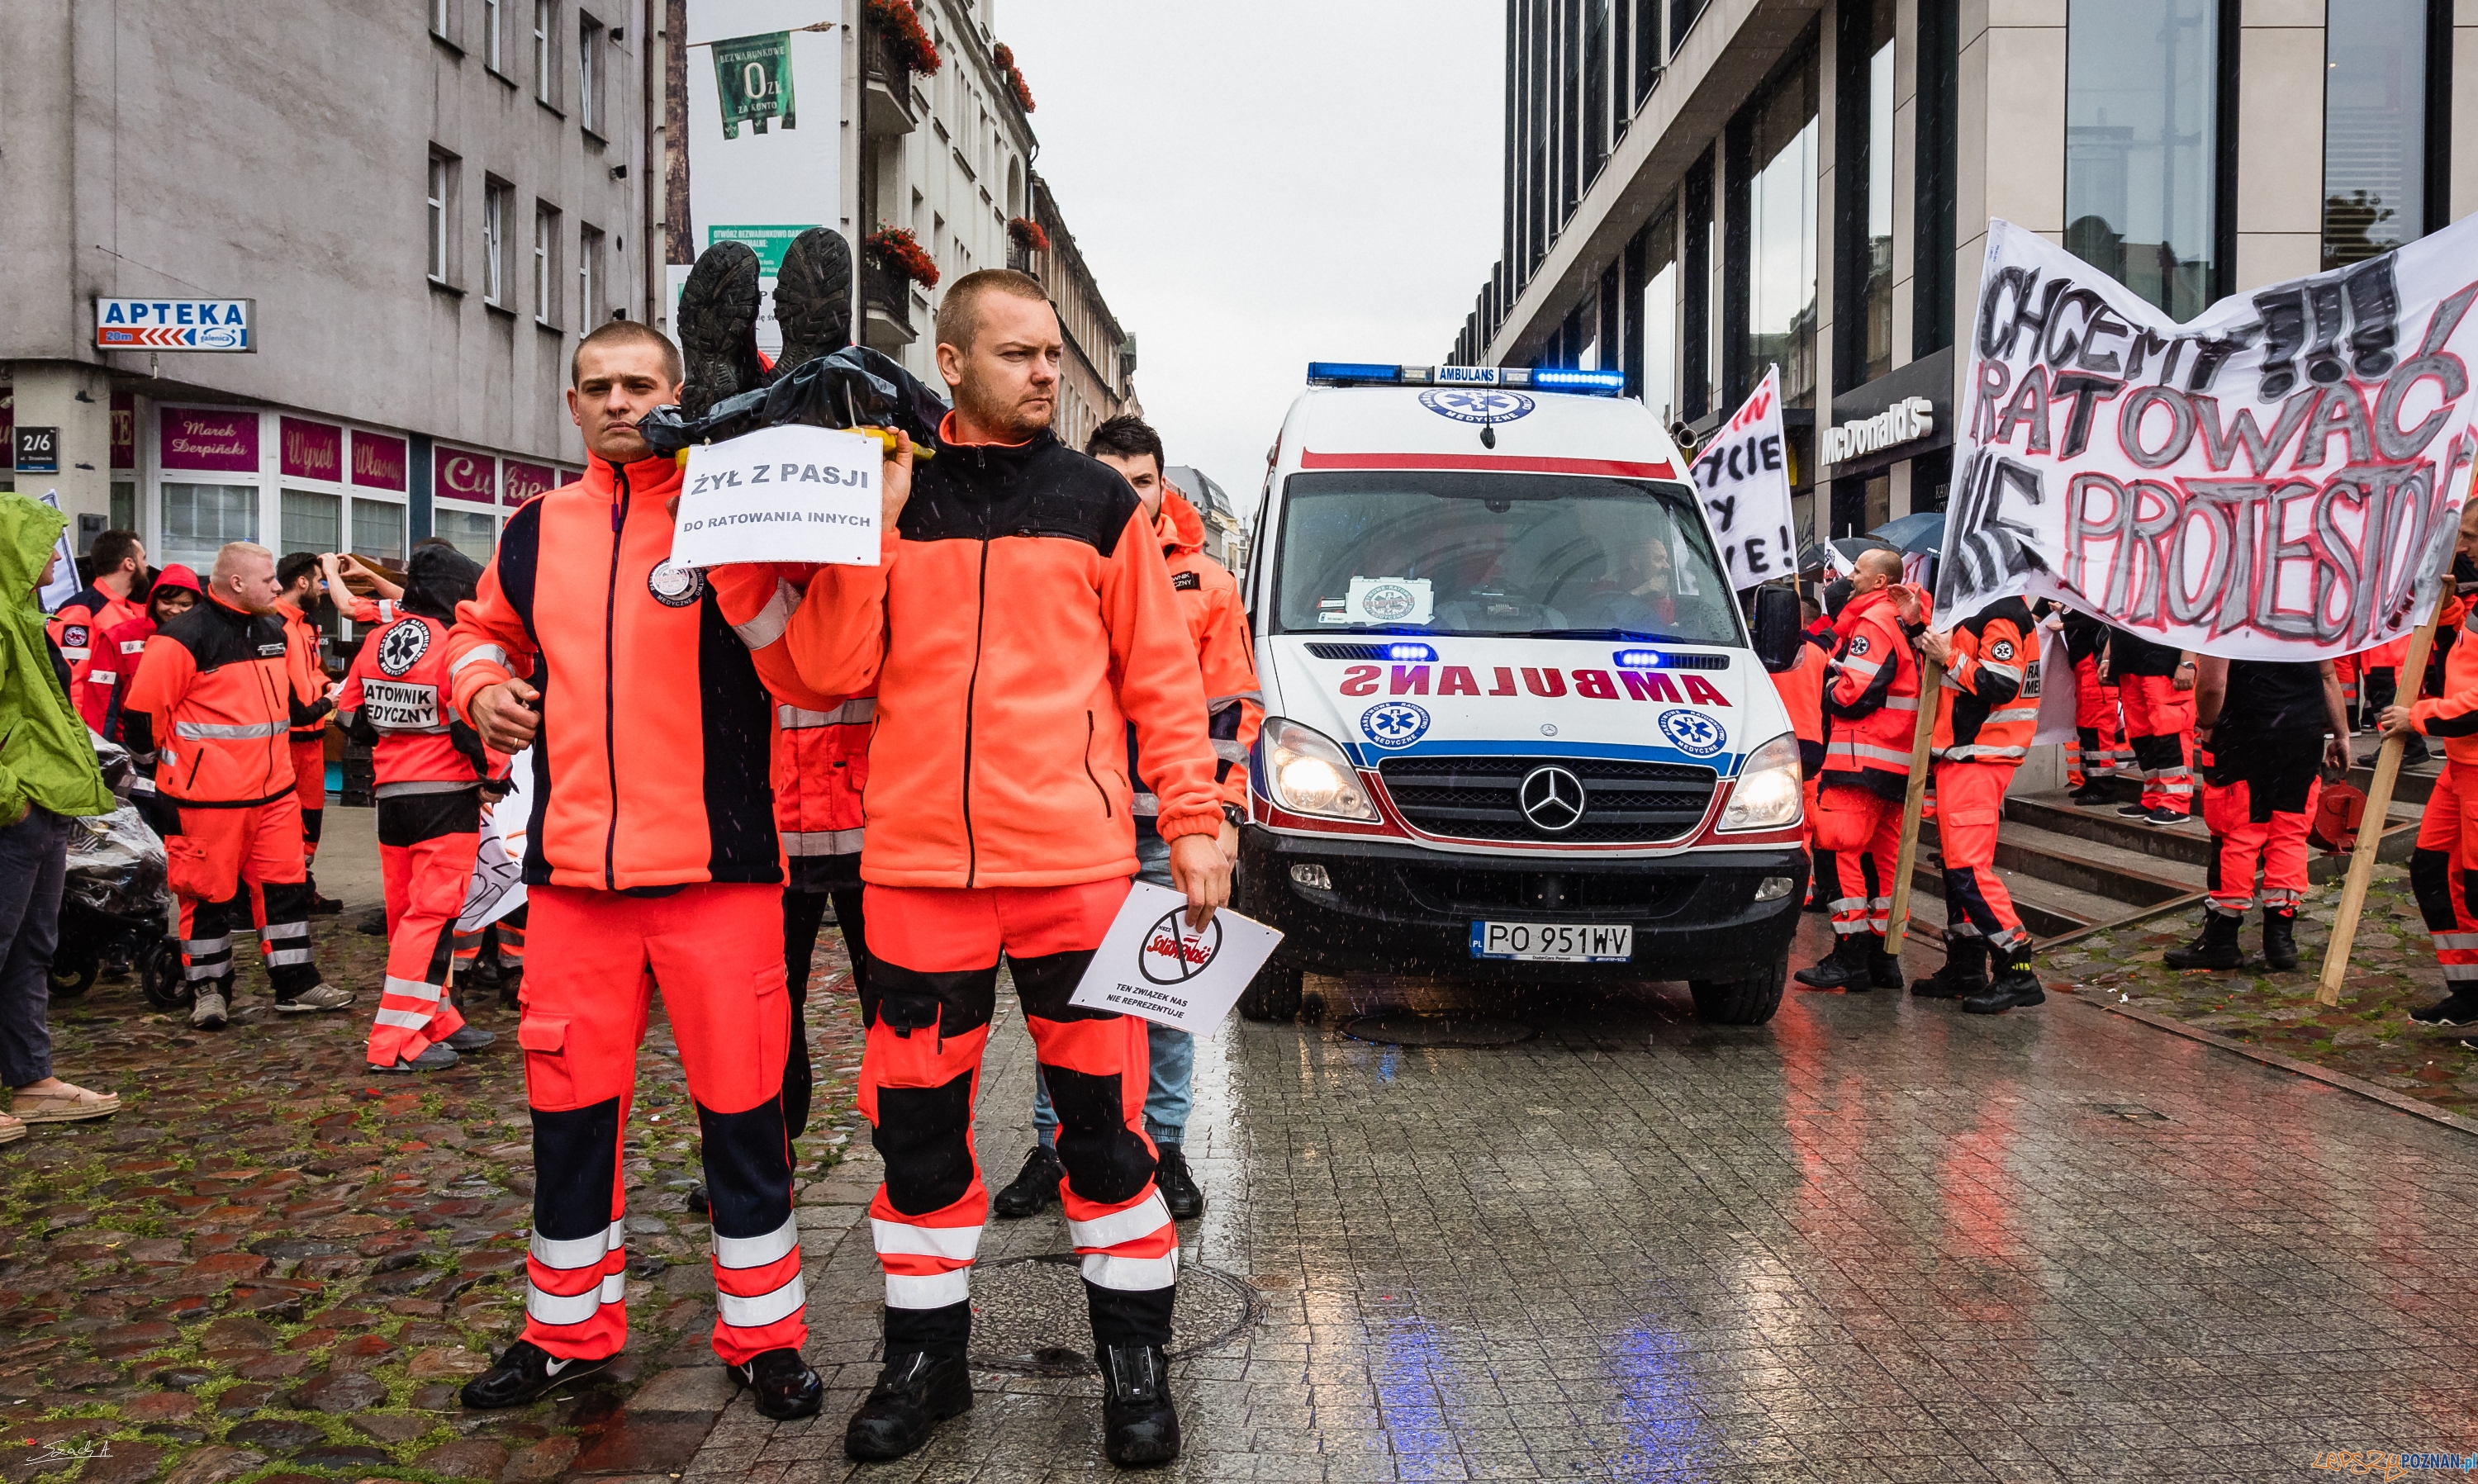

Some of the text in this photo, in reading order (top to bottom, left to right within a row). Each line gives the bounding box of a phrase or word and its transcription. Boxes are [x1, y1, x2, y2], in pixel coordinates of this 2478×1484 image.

[719, 46, 786, 64] BEZWARUNKOWE
[738, 102, 777, 114] ZA KONTO
[105, 303, 244, 325] APTEKA
[106, 332, 230, 343] 20m galenica
[1440, 367, 1494, 382] AMBULANS
[1972, 281, 2478, 476] RATOWAĆ
[1445, 411, 1519, 423] MEDYCZNE
[183, 421, 237, 437] Marek
[1821, 396, 1933, 466] McDonald's
[23, 434, 50, 451] 2/6
[287, 430, 335, 475] Wyrób
[691, 463, 868, 495] ŻYŁ Z PASJI
[683, 512, 871, 533] DO RATOWANIA INNYCH
[657, 595, 693, 606] MEDYCZNE
[365, 685, 431, 704] ATOWNIK
[367, 704, 434, 723] EDYCZNY
[1374, 733, 1417, 745] MEDYCZNE
[1678, 741, 1718, 753] MEDYCZNE
[1489, 925, 1530, 951] PO
[1540, 927, 1627, 954] 951WV
[1116, 983, 1188, 1008] TEN ZWIĄZEK NAS
[1106, 993, 1185, 1019] NIE REPREZENTUJE
